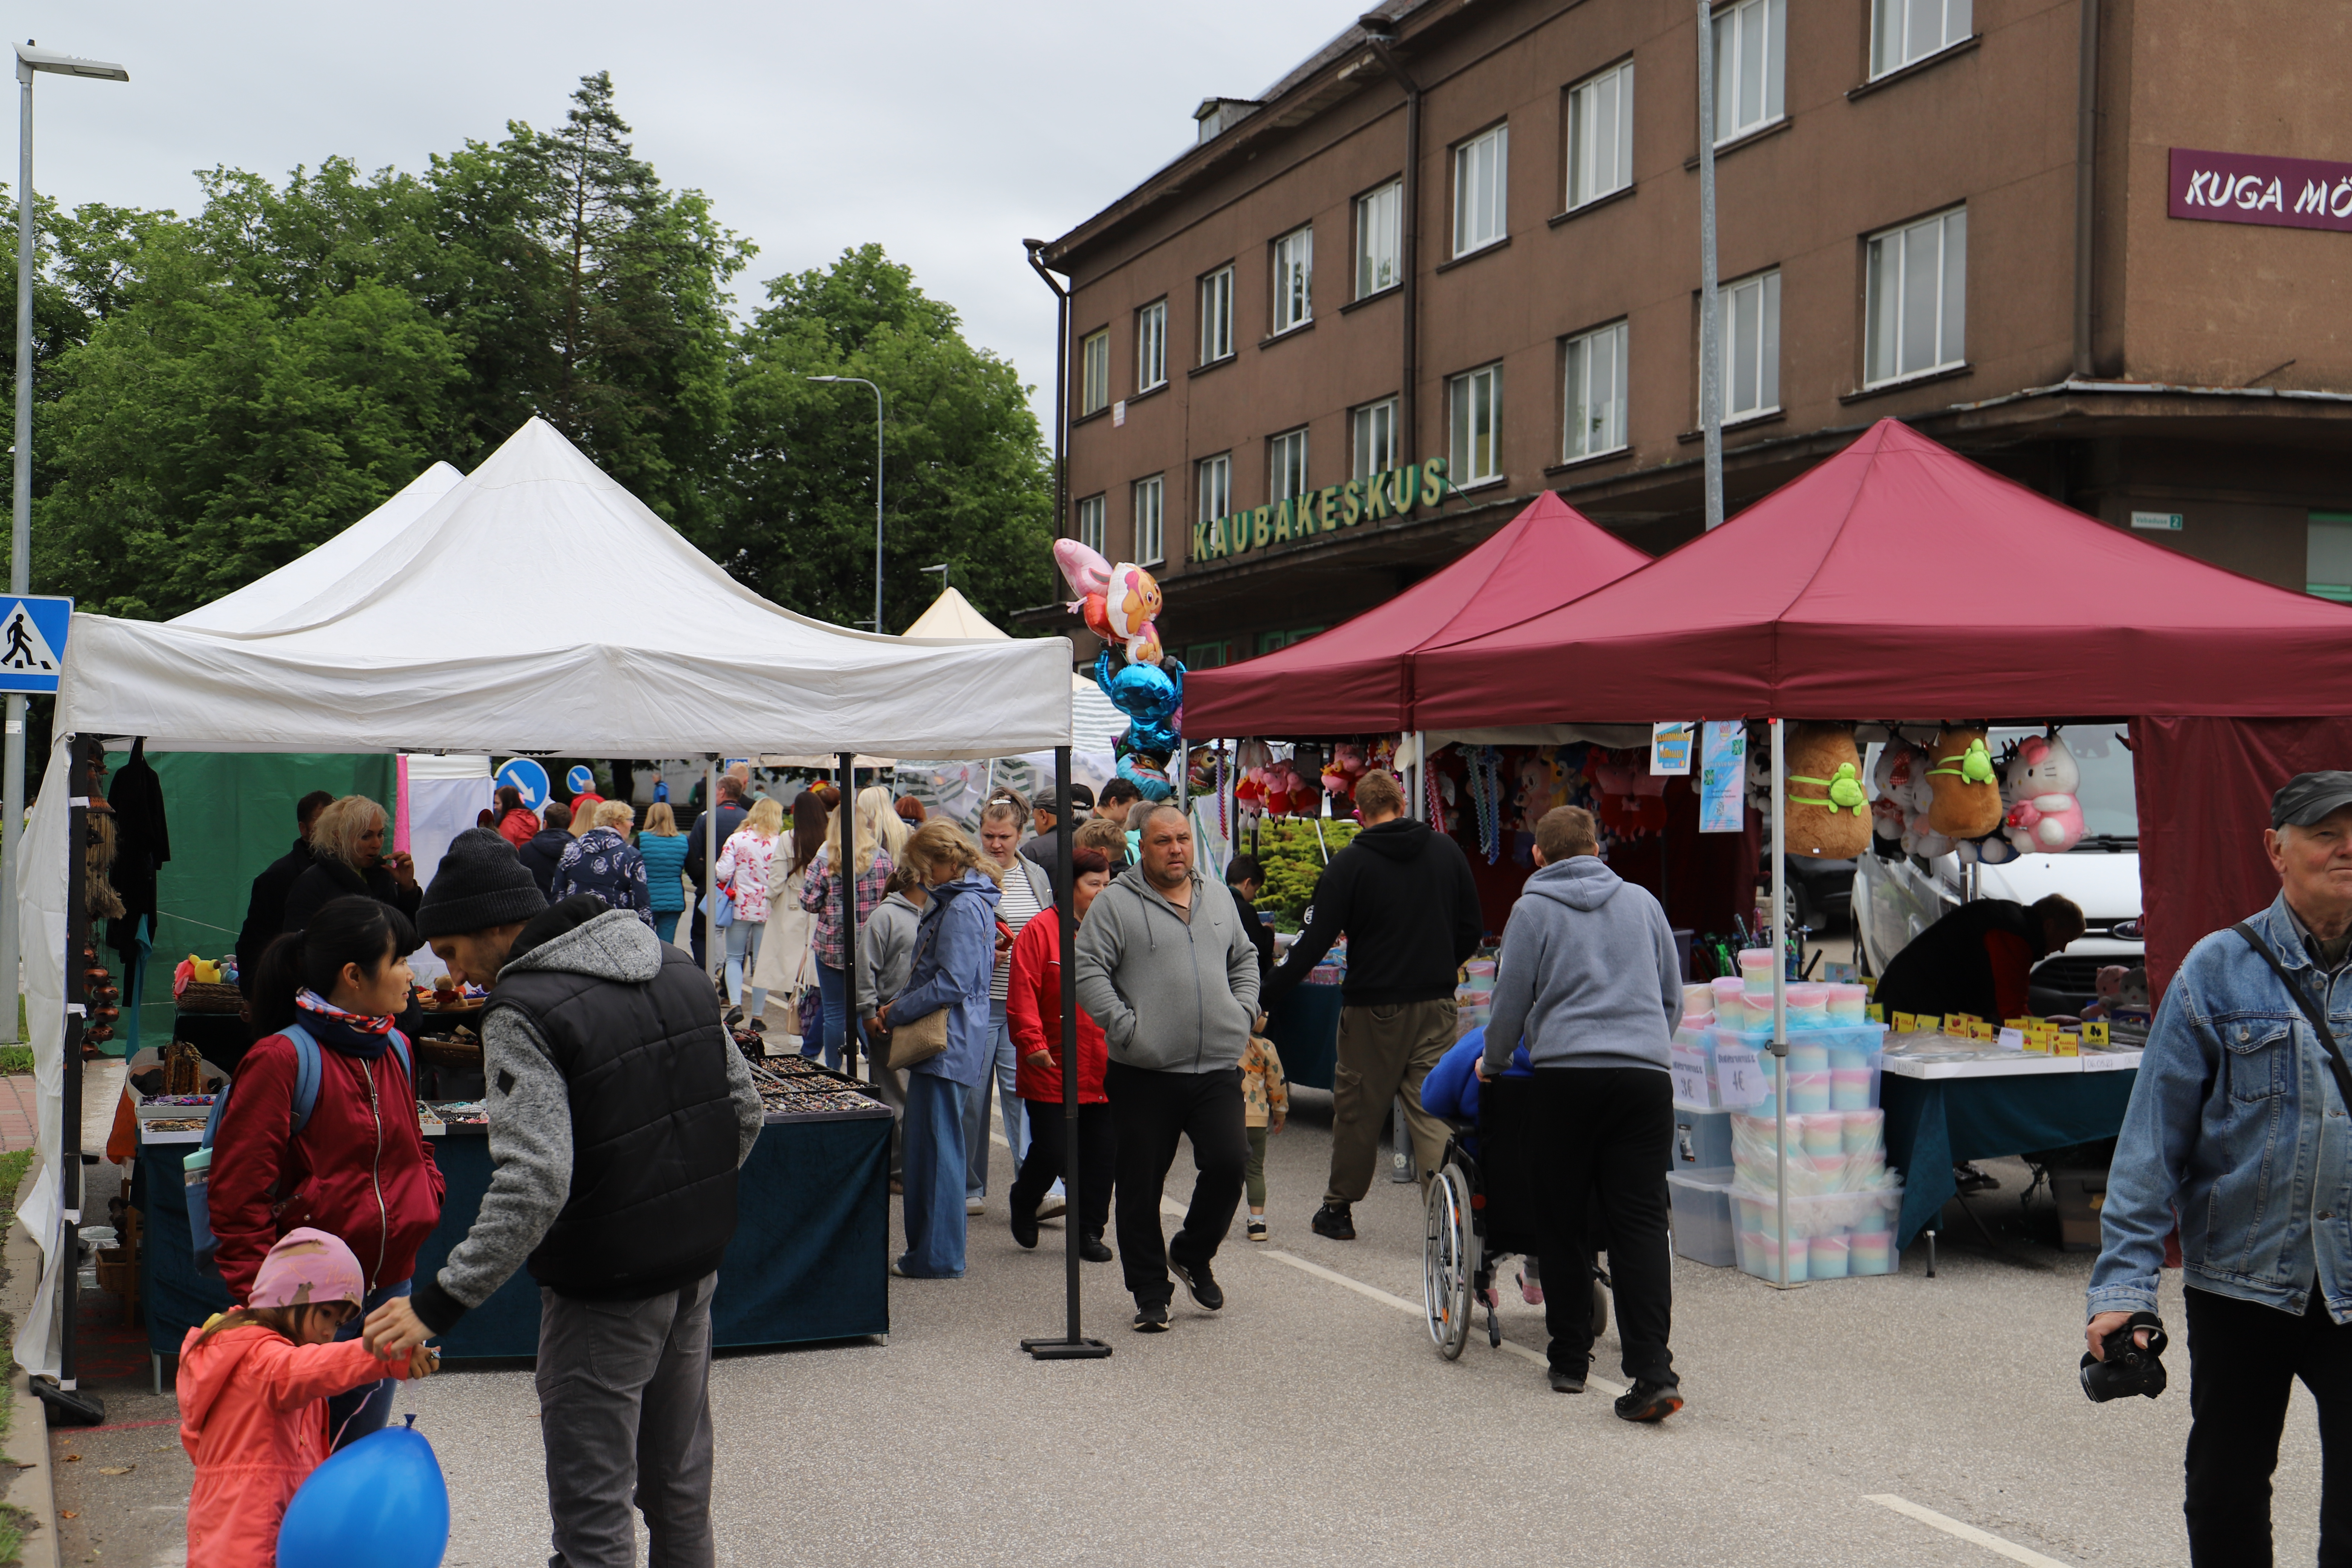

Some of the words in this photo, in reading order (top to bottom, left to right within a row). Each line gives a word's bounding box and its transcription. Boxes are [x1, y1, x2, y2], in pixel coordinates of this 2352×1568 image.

[2185, 169, 2283, 212] KUGA
[1193, 457, 1449, 564] KAUBAKESKUS
[2173, 516, 2179, 527] 2
[1655, 732, 1691, 742] KAARDIMAKSE
[1681, 1077, 1694, 1099] 3€
[1732, 1070, 1745, 1091] 4€
